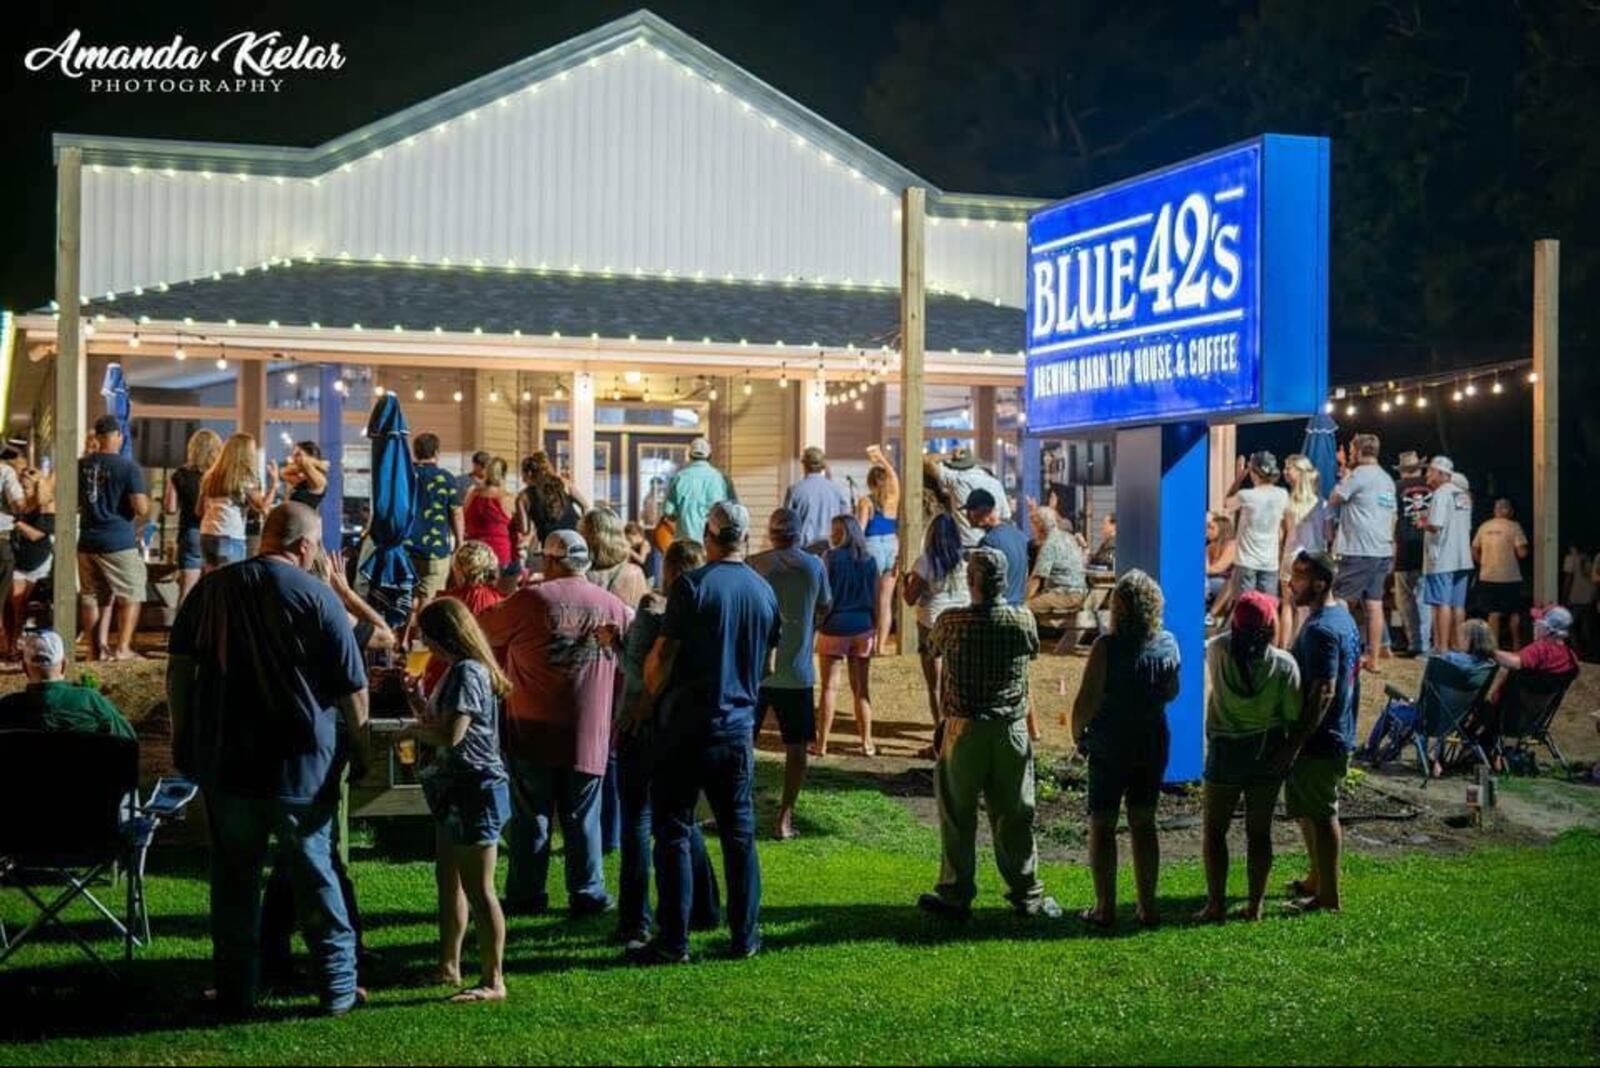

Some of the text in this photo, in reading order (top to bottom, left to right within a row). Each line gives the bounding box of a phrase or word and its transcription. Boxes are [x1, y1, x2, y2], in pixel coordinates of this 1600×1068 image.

[1032, 237, 1137, 338] BLUE
[1110, 349, 1131, 388] TAP
[1176, 341, 1186, 378] &
[1190, 332, 1237, 376] COFFEE
